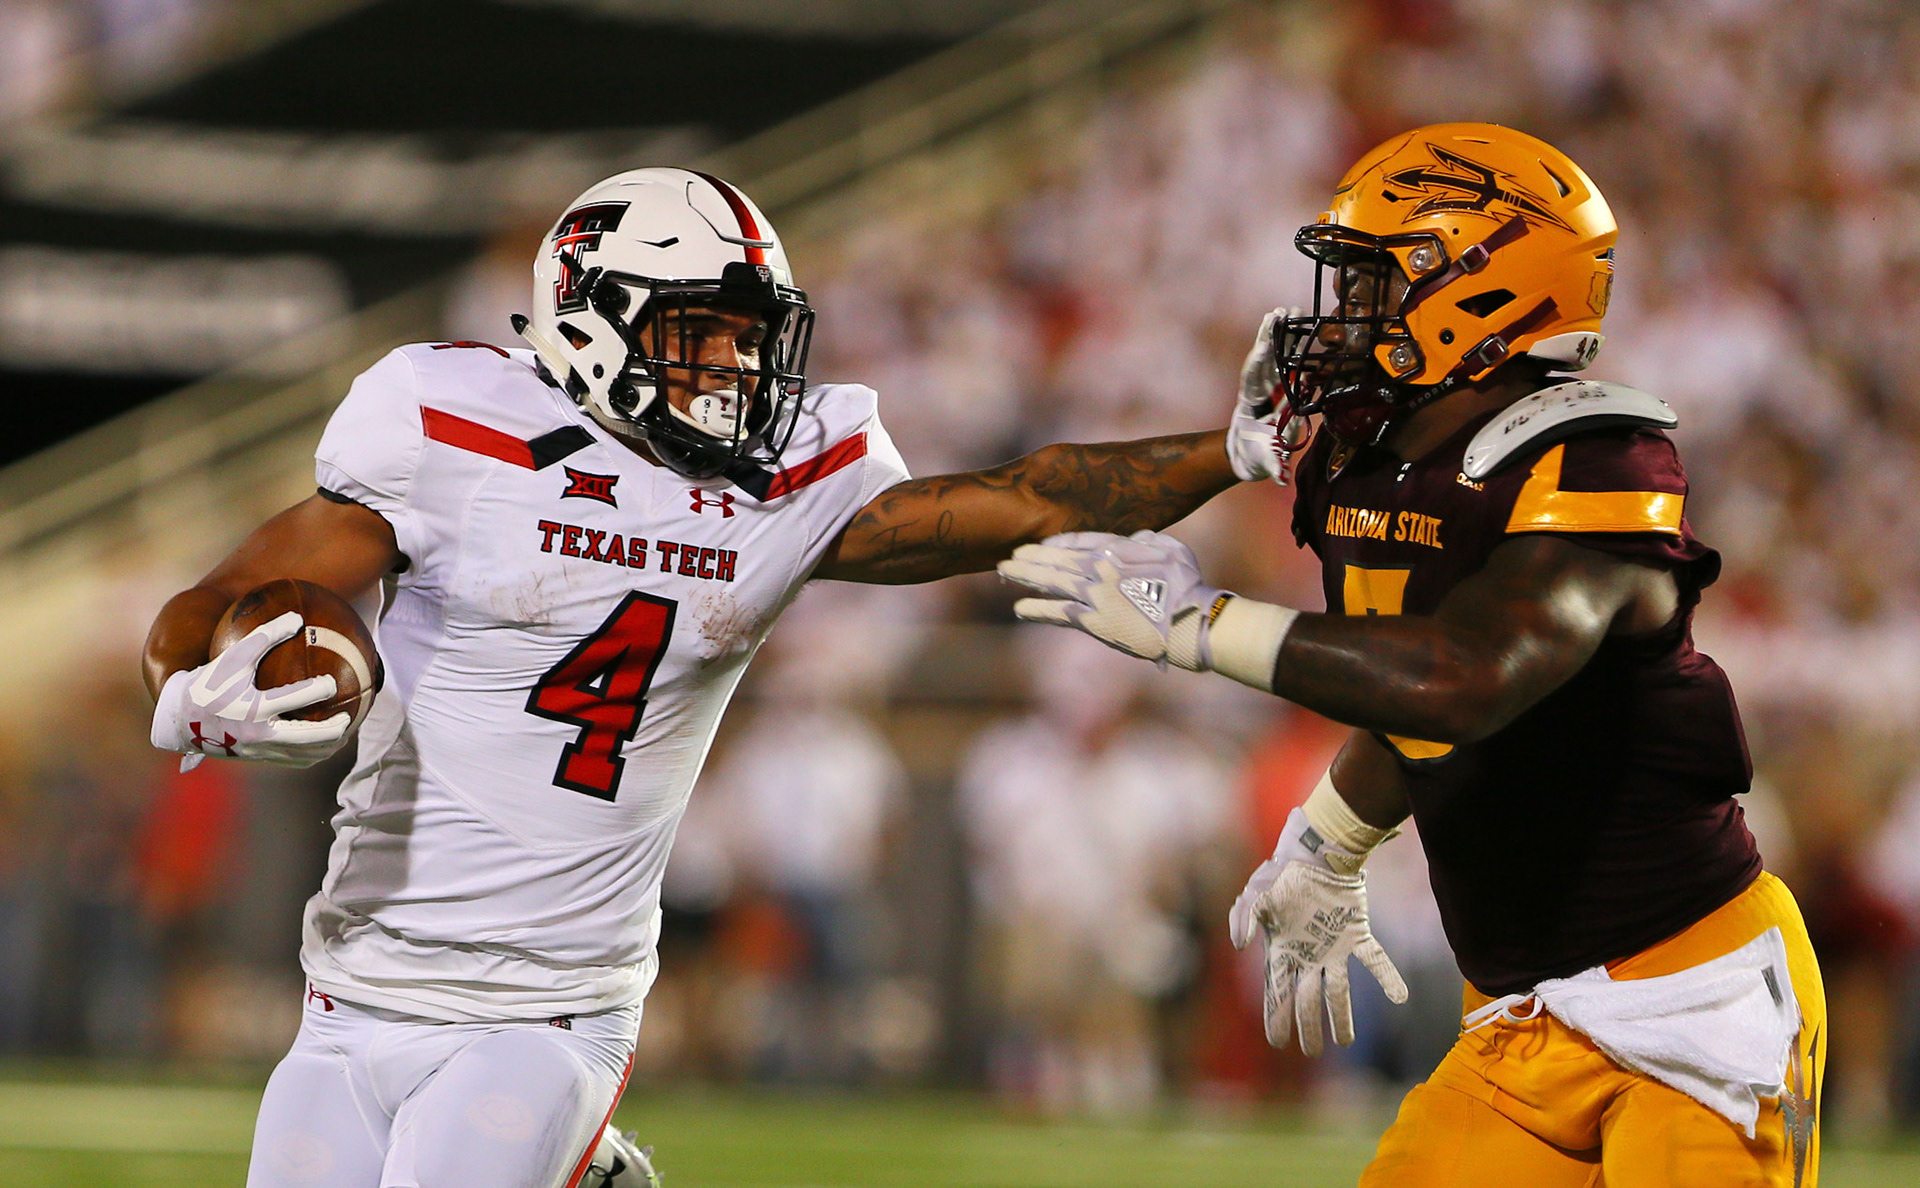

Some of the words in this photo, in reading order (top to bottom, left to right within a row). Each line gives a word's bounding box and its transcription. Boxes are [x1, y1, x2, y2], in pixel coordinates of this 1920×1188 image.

[538, 519, 648, 569] TEXAS
[656, 539, 738, 582] TECH
[1325, 504, 1391, 541] ARIZONA
[1394, 510, 1444, 549] STATE
[524, 589, 679, 803] 4
